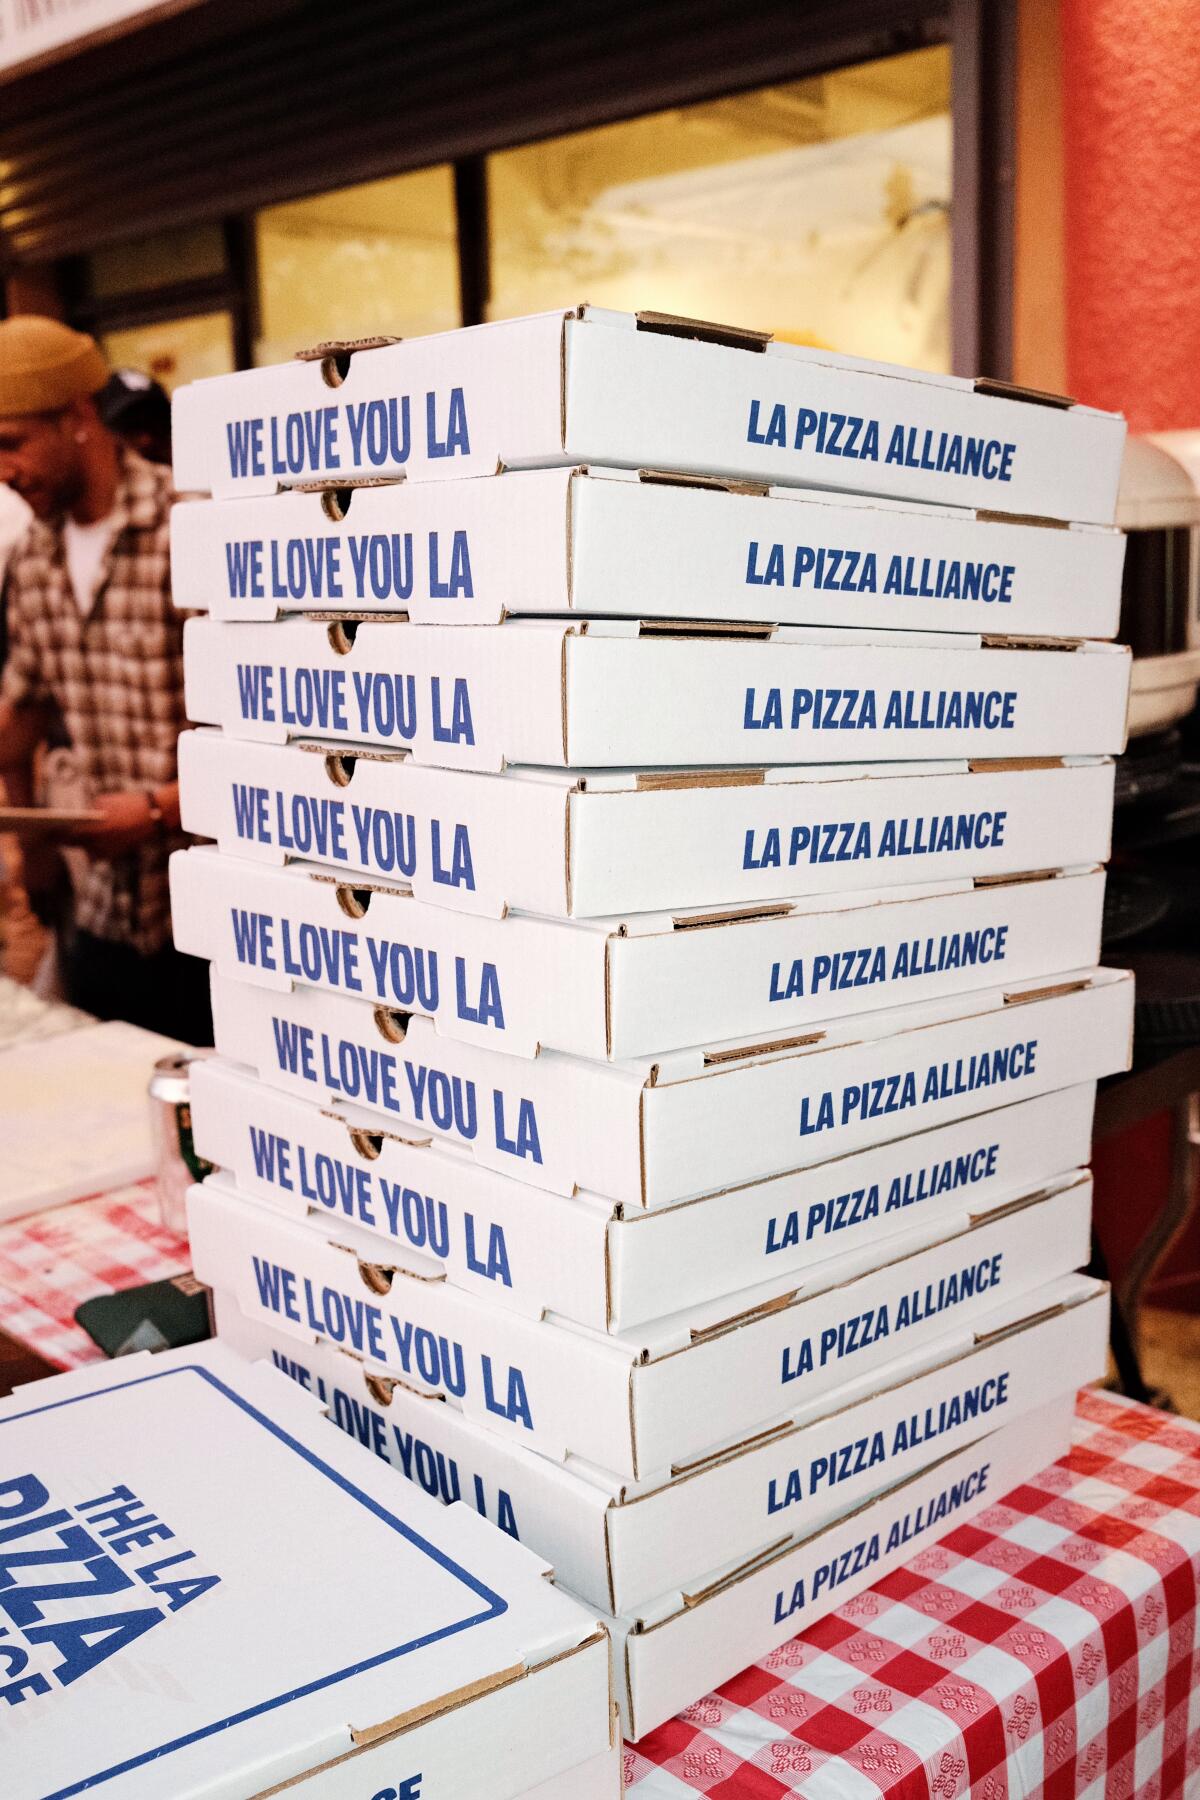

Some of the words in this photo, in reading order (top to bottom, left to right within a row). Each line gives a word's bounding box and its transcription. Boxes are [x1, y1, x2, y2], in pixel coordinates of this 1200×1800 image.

[226, 419, 264, 477] WE
[271, 408, 340, 475] LOVE
[346, 398, 410, 466] YOU
[426, 388, 470, 459] LA
[747, 398, 786, 448] LA
[793, 406, 878, 462] PIZZA
[885, 423, 1016, 481] ALLIANCE
[226, 541, 264, 598] WE
[271, 537, 342, 599] LOVE
[348, 534, 413, 600] YOU
[428, 531, 473, 599] LA
[745, 540, 784, 587] LA
[792, 544, 876, 593] PIZZA
[882, 553, 1015, 603] ALLIANCE
[238, 666, 274, 722] WE
[280, 668, 347, 730] LOVE
[352, 671, 416, 740] YOU
[431, 678, 474, 746] LA
[743, 686, 782, 730] LA
[790, 687, 876, 730] PIZZA
[883, 689, 1016, 730] ALLIANCE
[233, 783, 271, 844] WE
[277, 793, 347, 861] LOVE
[352, 806, 416, 877] YOU
[431, 820, 475, 891] LA
[742, 826, 780, 870] LA
[788, 820, 871, 866] PIZZA
[877, 810, 1006, 858] ALLIANCE
[232, 910, 275, 971] WE
[282, 919, 361, 992] LOVE
[367, 938, 438, 1012] YOU
[455, 958, 504, 1030] LA
[768, 958, 803, 1002] LA
[810, 945, 885, 995] PIZZA
[892, 925, 1008, 980] ALLIANCE
[272, 1020, 316, 1081] WE
[321, 1034, 399, 1112] LOVE
[405, 1062, 477, 1140] YOU
[493, 1091, 542, 1164] LA
[799, 1090, 834, 1137] LA
[841, 1070, 916, 1126] PIZZA
[922, 1039, 1036, 1104] ALLIANCE
[249, 1127, 294, 1190] WE
[298, 1146, 375, 1226] LOVE
[379, 1178, 448, 1258] YOU
[464, 1214, 512, 1288] LA
[765, 1210, 799, 1254] LA
[805, 1183, 878, 1240] PIZZA
[884, 1144, 996, 1212] ALLIANCE
[252, 1257, 301, 1322] WE
[304, 1278, 386, 1361] LOVE
[390, 1315, 466, 1398] YOU
[481, 1355, 533, 1430] LA
[781, 1337, 813, 1383] LA
[820, 1305, 889, 1365] PIZZA
[895, 1253, 1001, 1330] ALLIANCE
[393, 1423, 461, 1505] YOU
[767, 1469, 801, 1514] LA
[809, 1431, 885, 1494] PIZZA
[892, 1373, 1007, 1456] ALLIANCE
[75, 1483, 175, 1556] THE
[134, 1550, 220, 1612] LA
[774, 1590, 804, 1625] LA
[811, 1534, 880, 1602] PIZZA
[885, 1463, 990, 1555] ALLIANCE
